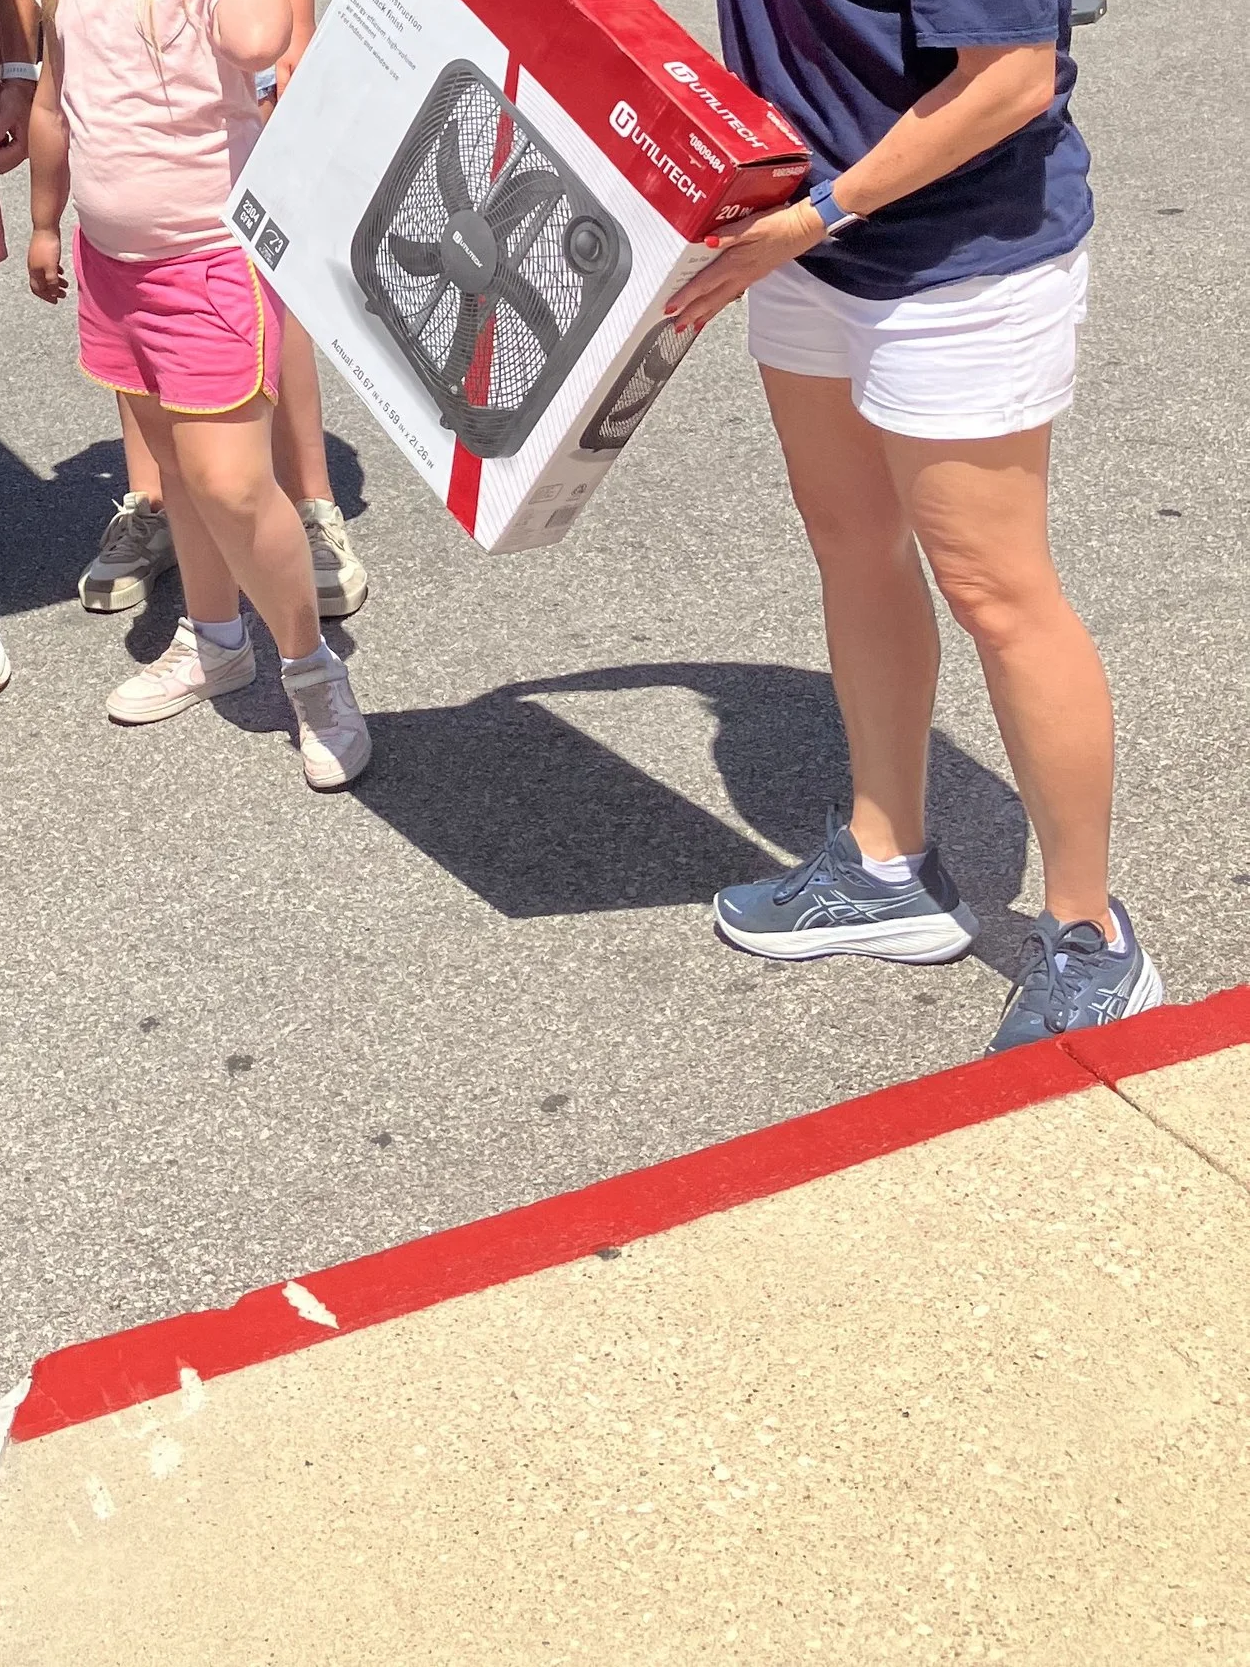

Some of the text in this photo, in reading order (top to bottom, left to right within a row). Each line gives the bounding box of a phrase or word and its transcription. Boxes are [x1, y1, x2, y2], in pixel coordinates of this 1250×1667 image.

[385, 7, 404, 32] finish
[715, 204, 740, 221] 20
[331, 338, 354, 368] Actual:
[352, 365, 375, 391] 20.67
[382, 401, 400, 424] 5.59
[408, 435, 429, 461] 21.26
